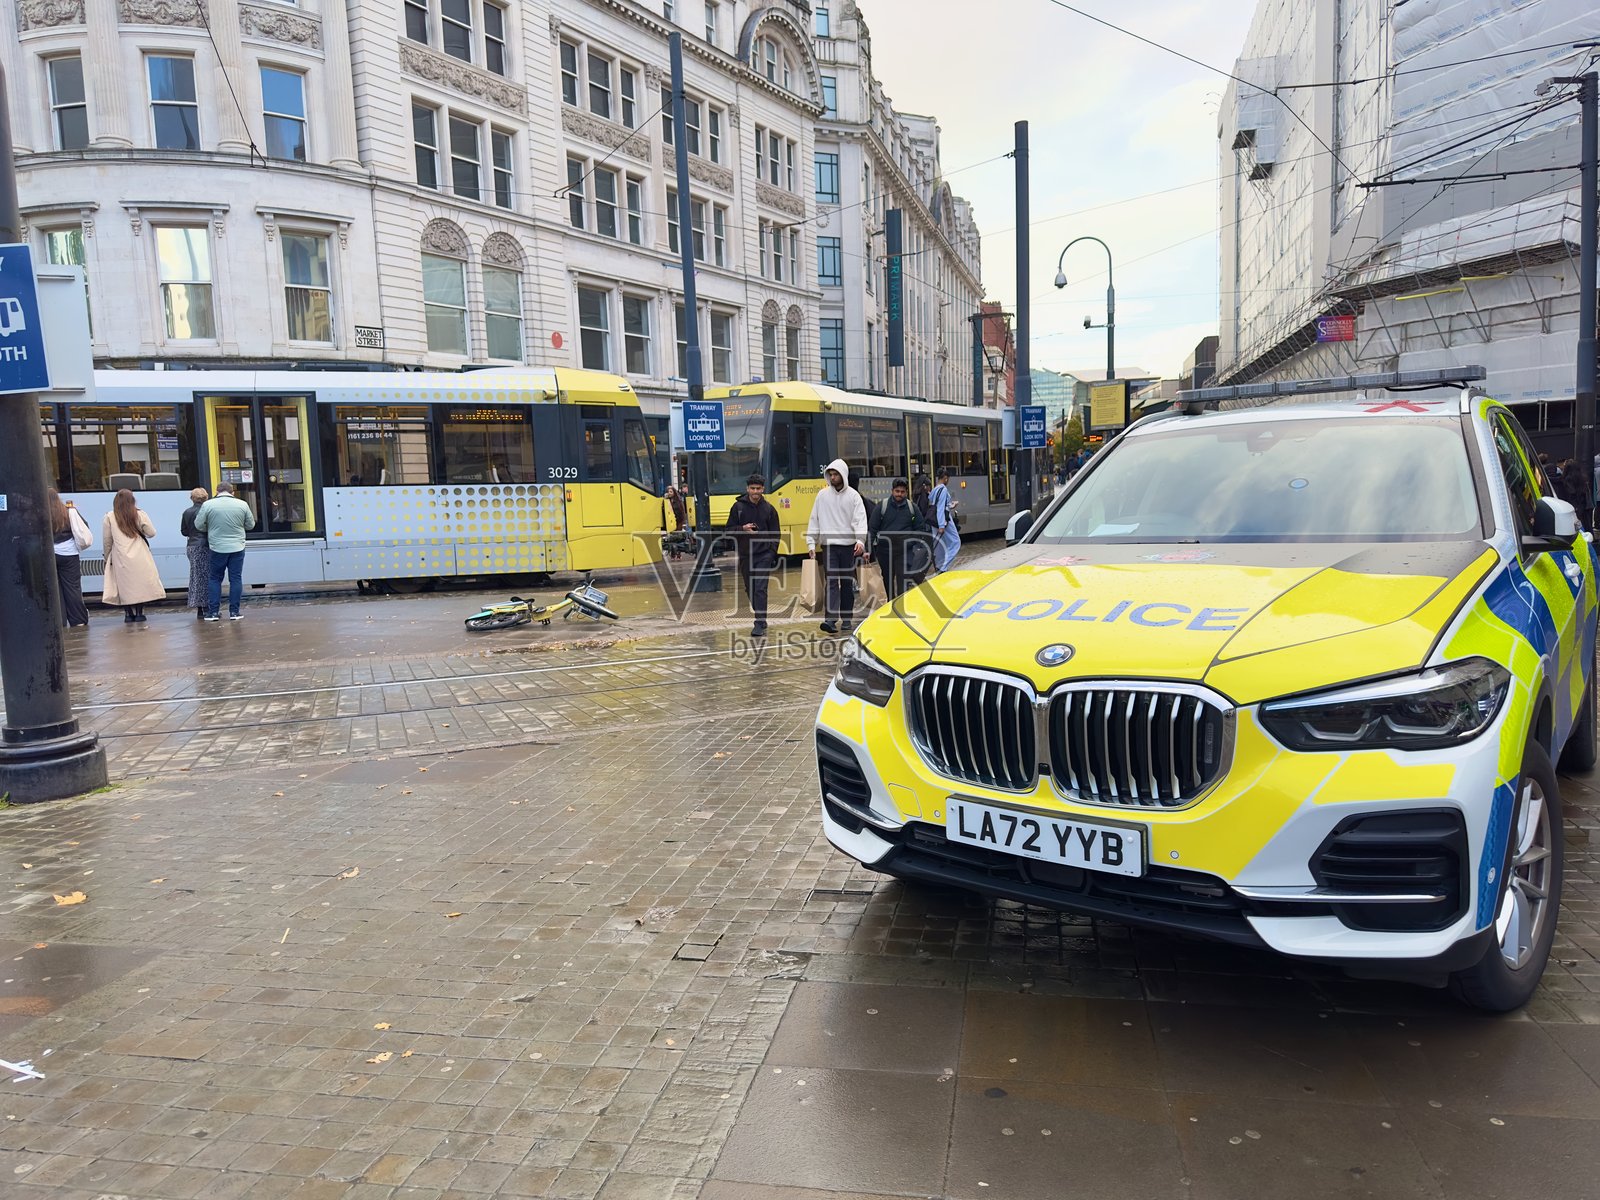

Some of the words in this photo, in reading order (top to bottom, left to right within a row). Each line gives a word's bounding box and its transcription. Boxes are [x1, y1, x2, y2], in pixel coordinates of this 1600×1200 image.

[891, 256, 900, 321] PRIMARK
[356, 329, 382, 338] MARKET
[357, 337, 382, 346] STREET
[0, 346, 27, 361] TH
[548, 467, 578, 479] 3029
[962, 598, 1249, 631] POLICE
[958, 805, 1041, 853] LA72
[1052, 823, 1124, 867] YYB
